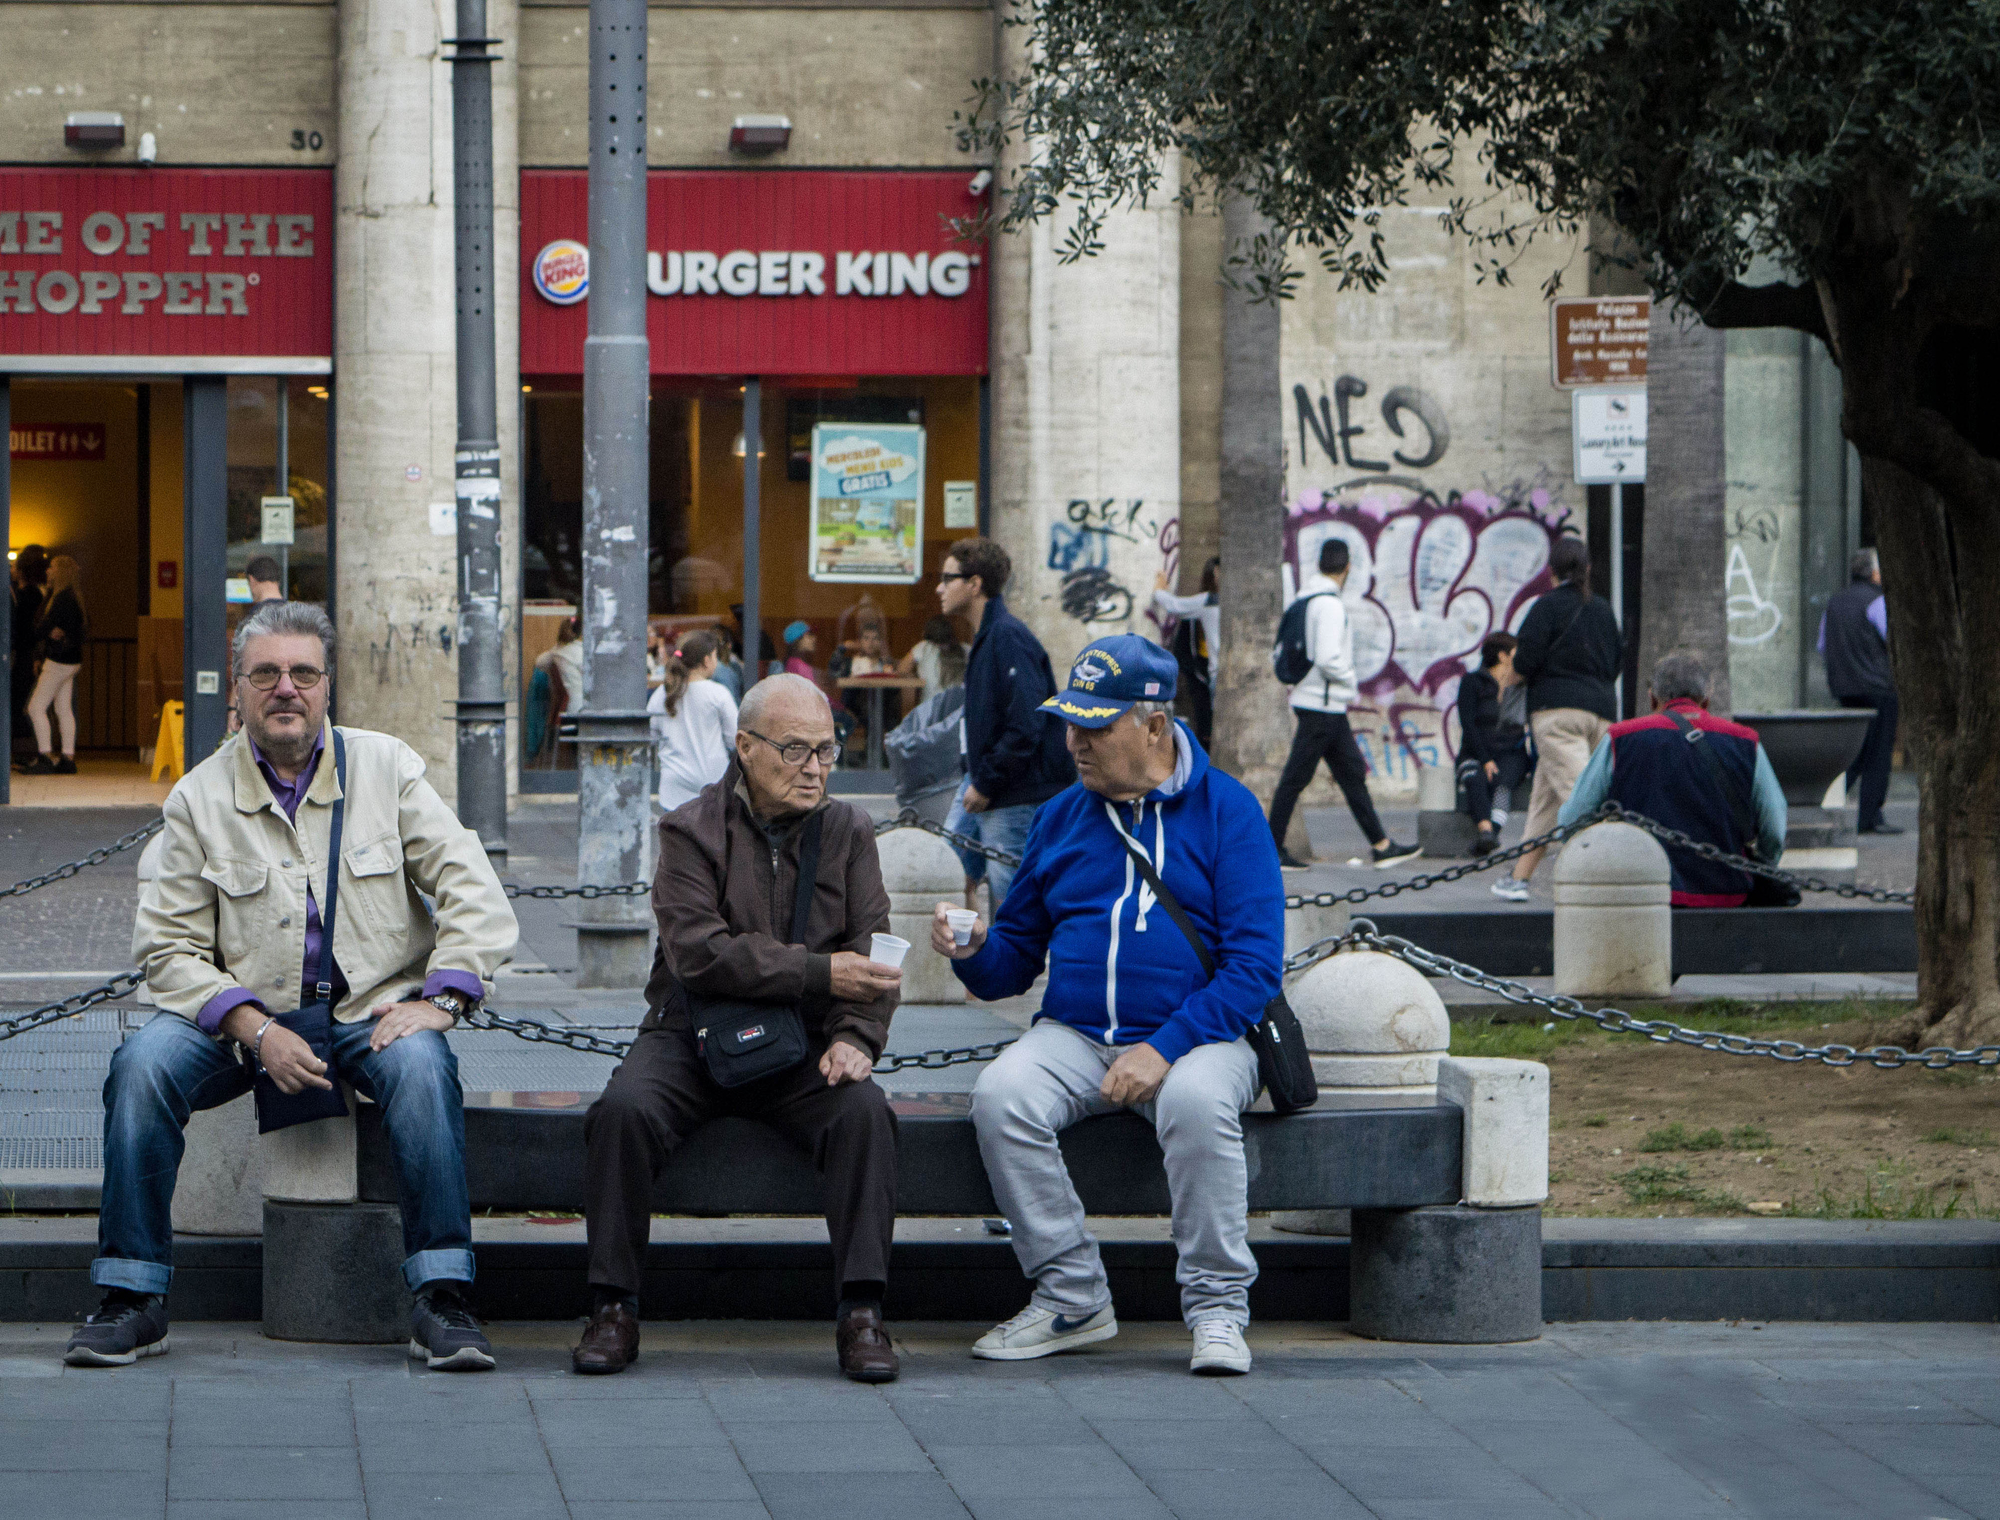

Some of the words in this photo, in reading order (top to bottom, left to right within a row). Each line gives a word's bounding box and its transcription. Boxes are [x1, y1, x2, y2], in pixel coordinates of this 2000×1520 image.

[81, 211, 165, 256] OF
[180, 213, 314, 257] THE
[0, 270, 249, 315] HOPPER
[646, 250, 826, 296] URGER
[835, 250, 972, 297] KING
[10, 430, 56, 452] OILET
